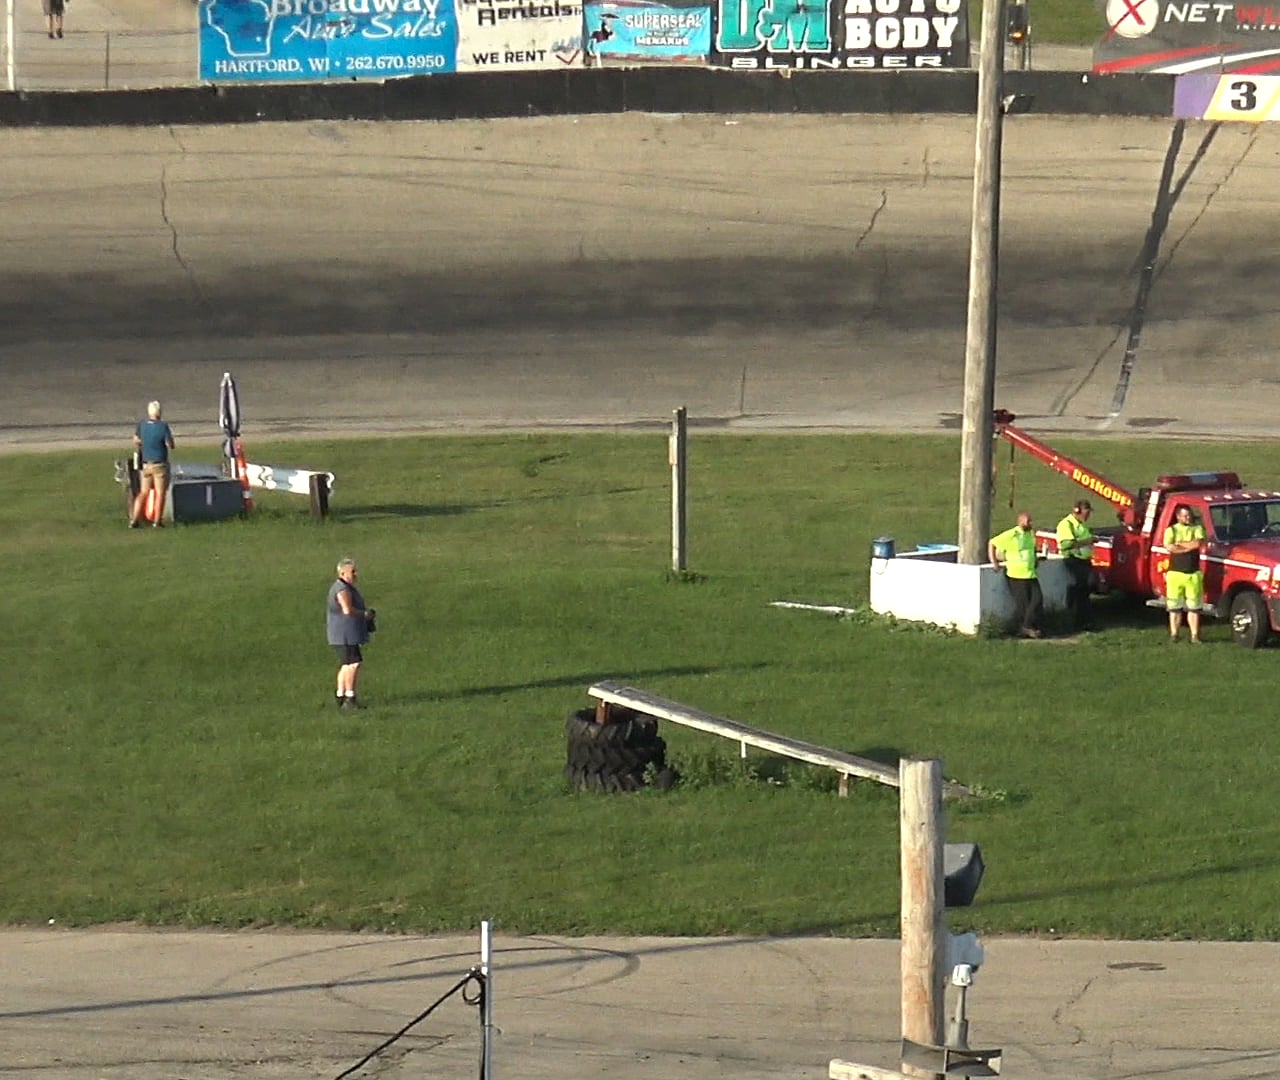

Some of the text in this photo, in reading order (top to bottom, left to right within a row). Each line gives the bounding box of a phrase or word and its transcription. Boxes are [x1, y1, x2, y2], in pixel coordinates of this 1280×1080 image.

[362, 13, 447, 38] Sales
[844, 17, 959, 49] BODY
[215, 54, 446, 74] HARTFORD, WI 262.670.9950
[472, 49, 547, 65] WE RENT
[731, 55, 944, 69] SLINGER
[1230, 81, 1257, 111] 3
